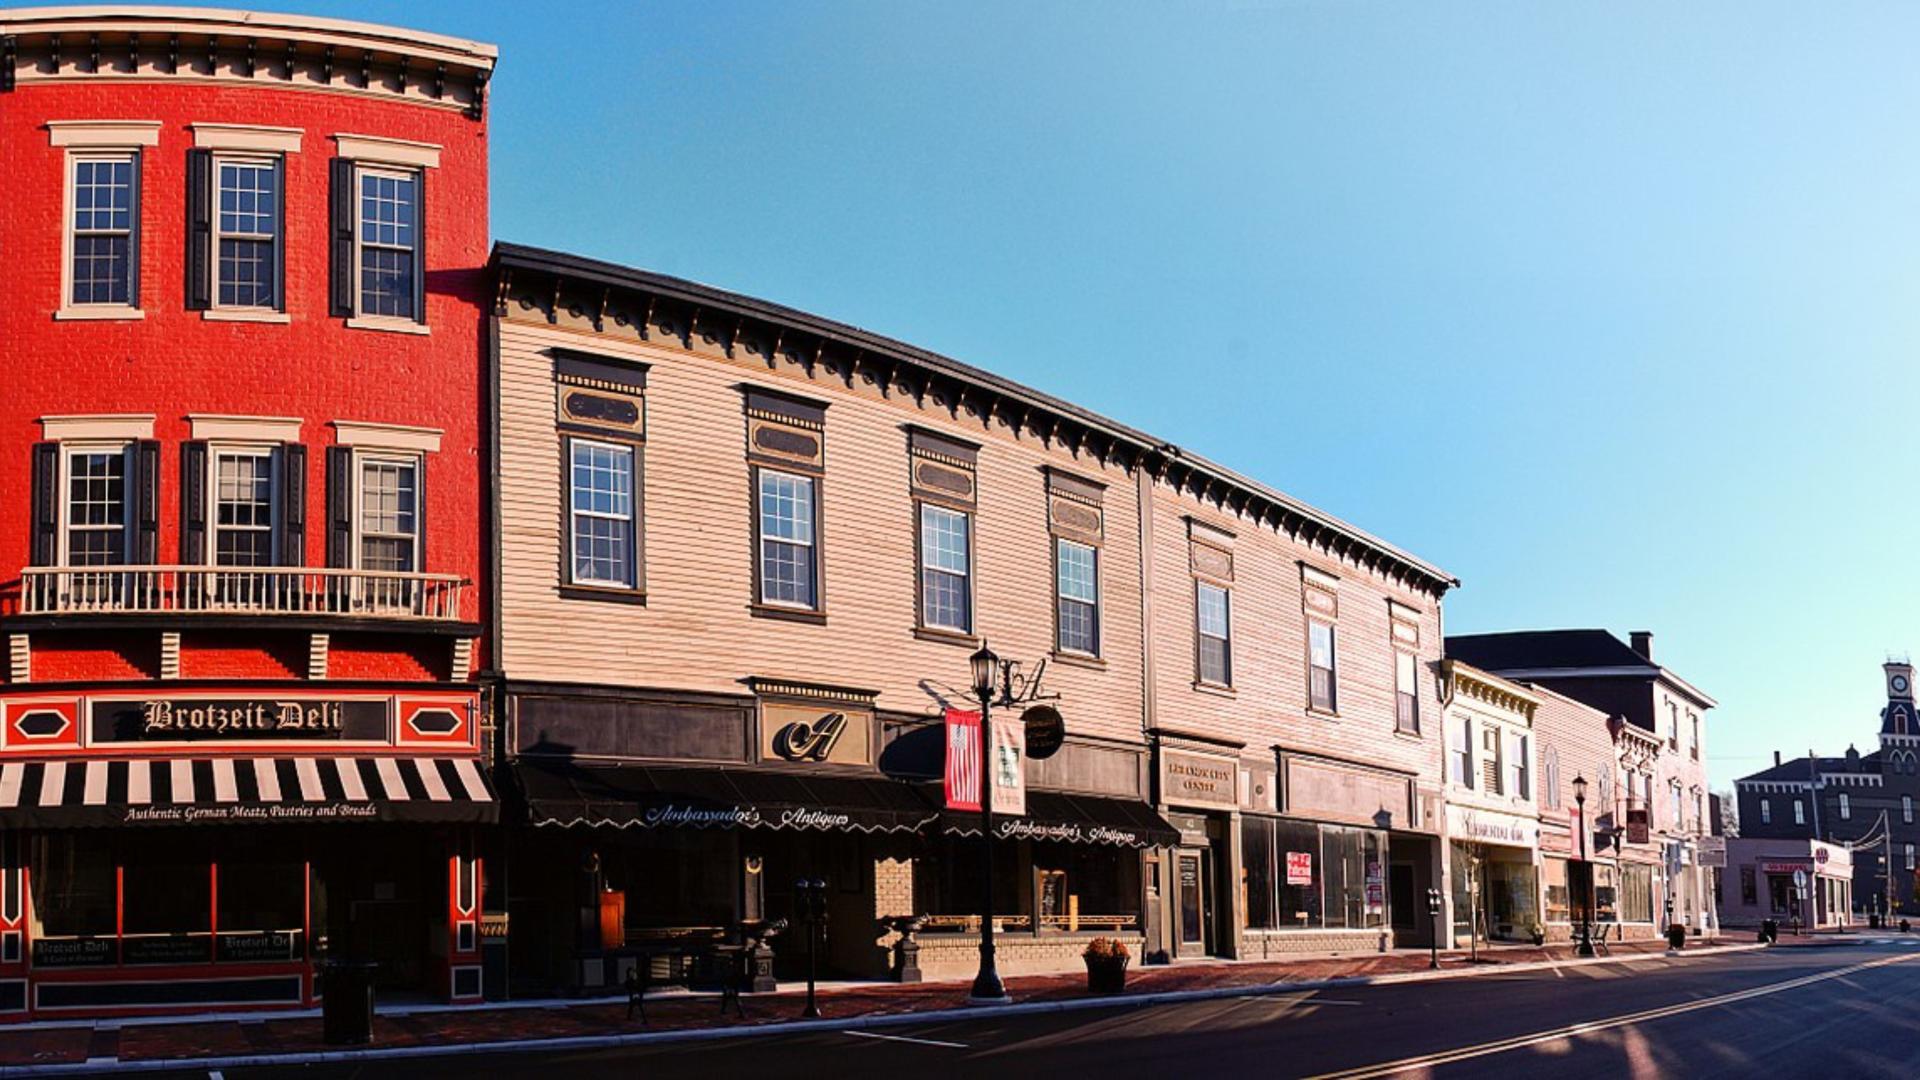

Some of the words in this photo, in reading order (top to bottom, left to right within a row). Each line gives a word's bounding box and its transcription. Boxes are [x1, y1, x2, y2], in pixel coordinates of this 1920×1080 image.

[143, 700, 267, 735] Brotzeit
[276, 701, 340, 730] Deli
[124, 805, 182, 822] Authentic
[184, 806, 228, 823] German
[229, 805, 268, 820] Meats,
[269, 804, 315, 819] Pastries
[317, 802, 341, 819] and
[339, 803, 378, 819] Breads
[646, 804, 761, 824] Ambassador's
[781, 807, 849, 827] Antiques
